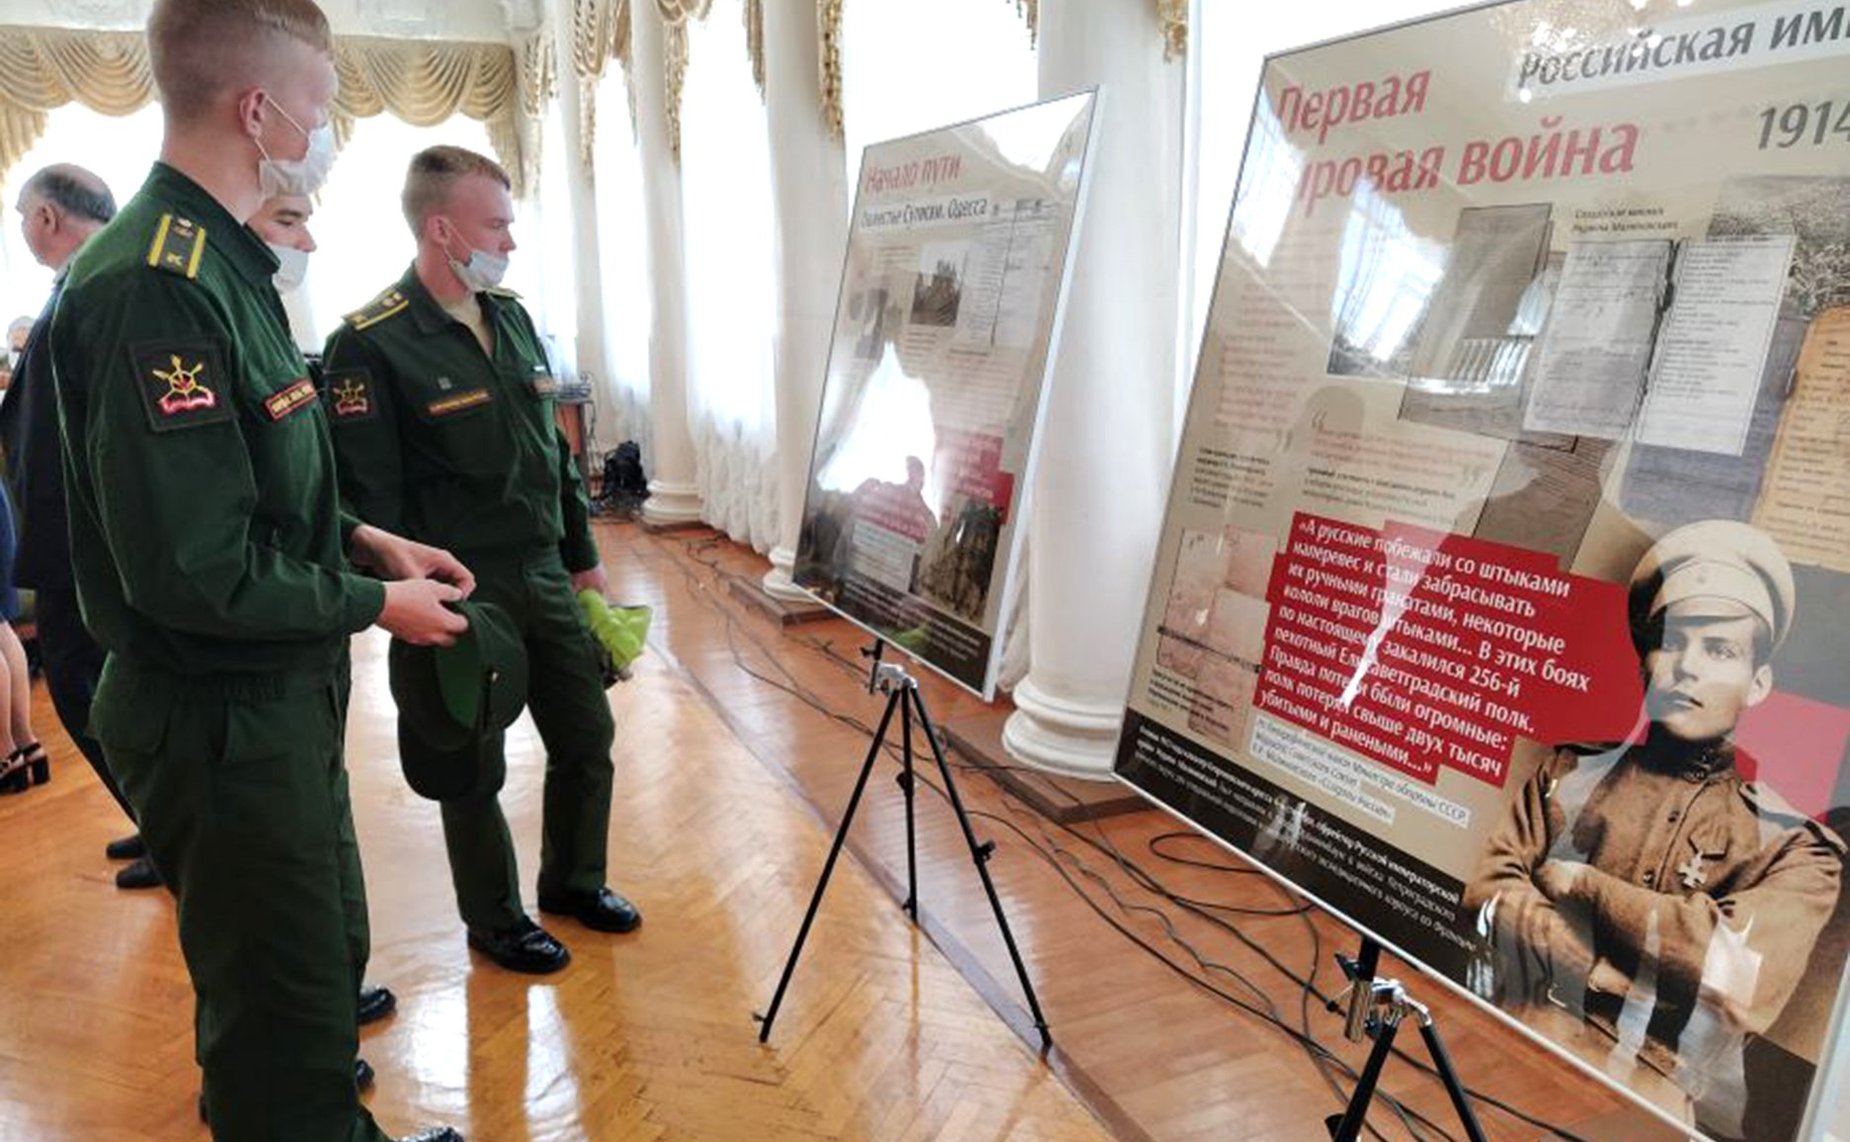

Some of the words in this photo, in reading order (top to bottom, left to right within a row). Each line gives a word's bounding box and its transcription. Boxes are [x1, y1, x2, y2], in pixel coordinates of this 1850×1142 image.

[1518, 22, 1755, 89] Российская
[1769, 7, 1850, 51] им
[1278, 71, 1431, 145] Первая
[1300, 146, 1445, 219] ровая
[1456, 115, 1639, 186] война
[1316, 523, 1374, 549] русские
[1454, 557, 1475, 575] со
[1478, 562, 1571, 598] штыками
[1362, 560, 1375, 574] и
[1421, 573, 1537, 618] забрасывать
[1296, 611, 1372, 648] настояще
[1381, 640, 1467, 680] закалился
[1468, 665, 1521, 698] 256-й
[1331, 599, 1381, 626] врагов
[1478, 640, 1492, 661] В
[1494, 648, 1538, 676] этих
[1541, 661, 1590, 693] боях
[1461, 611, 1566, 655] некоторые
[1319, 715, 1329, 730] и
[1338, 646, 1483, 713] Елаветградский
[1484, 701, 1535, 734] полк.
[1370, 682, 1412, 714] были
[1414, 703, 1508, 751] огромные:
[1353, 704, 1405, 736] свыше
[1404, 726, 1445, 755] двух
[1448, 743, 1502, 777] тысяч
